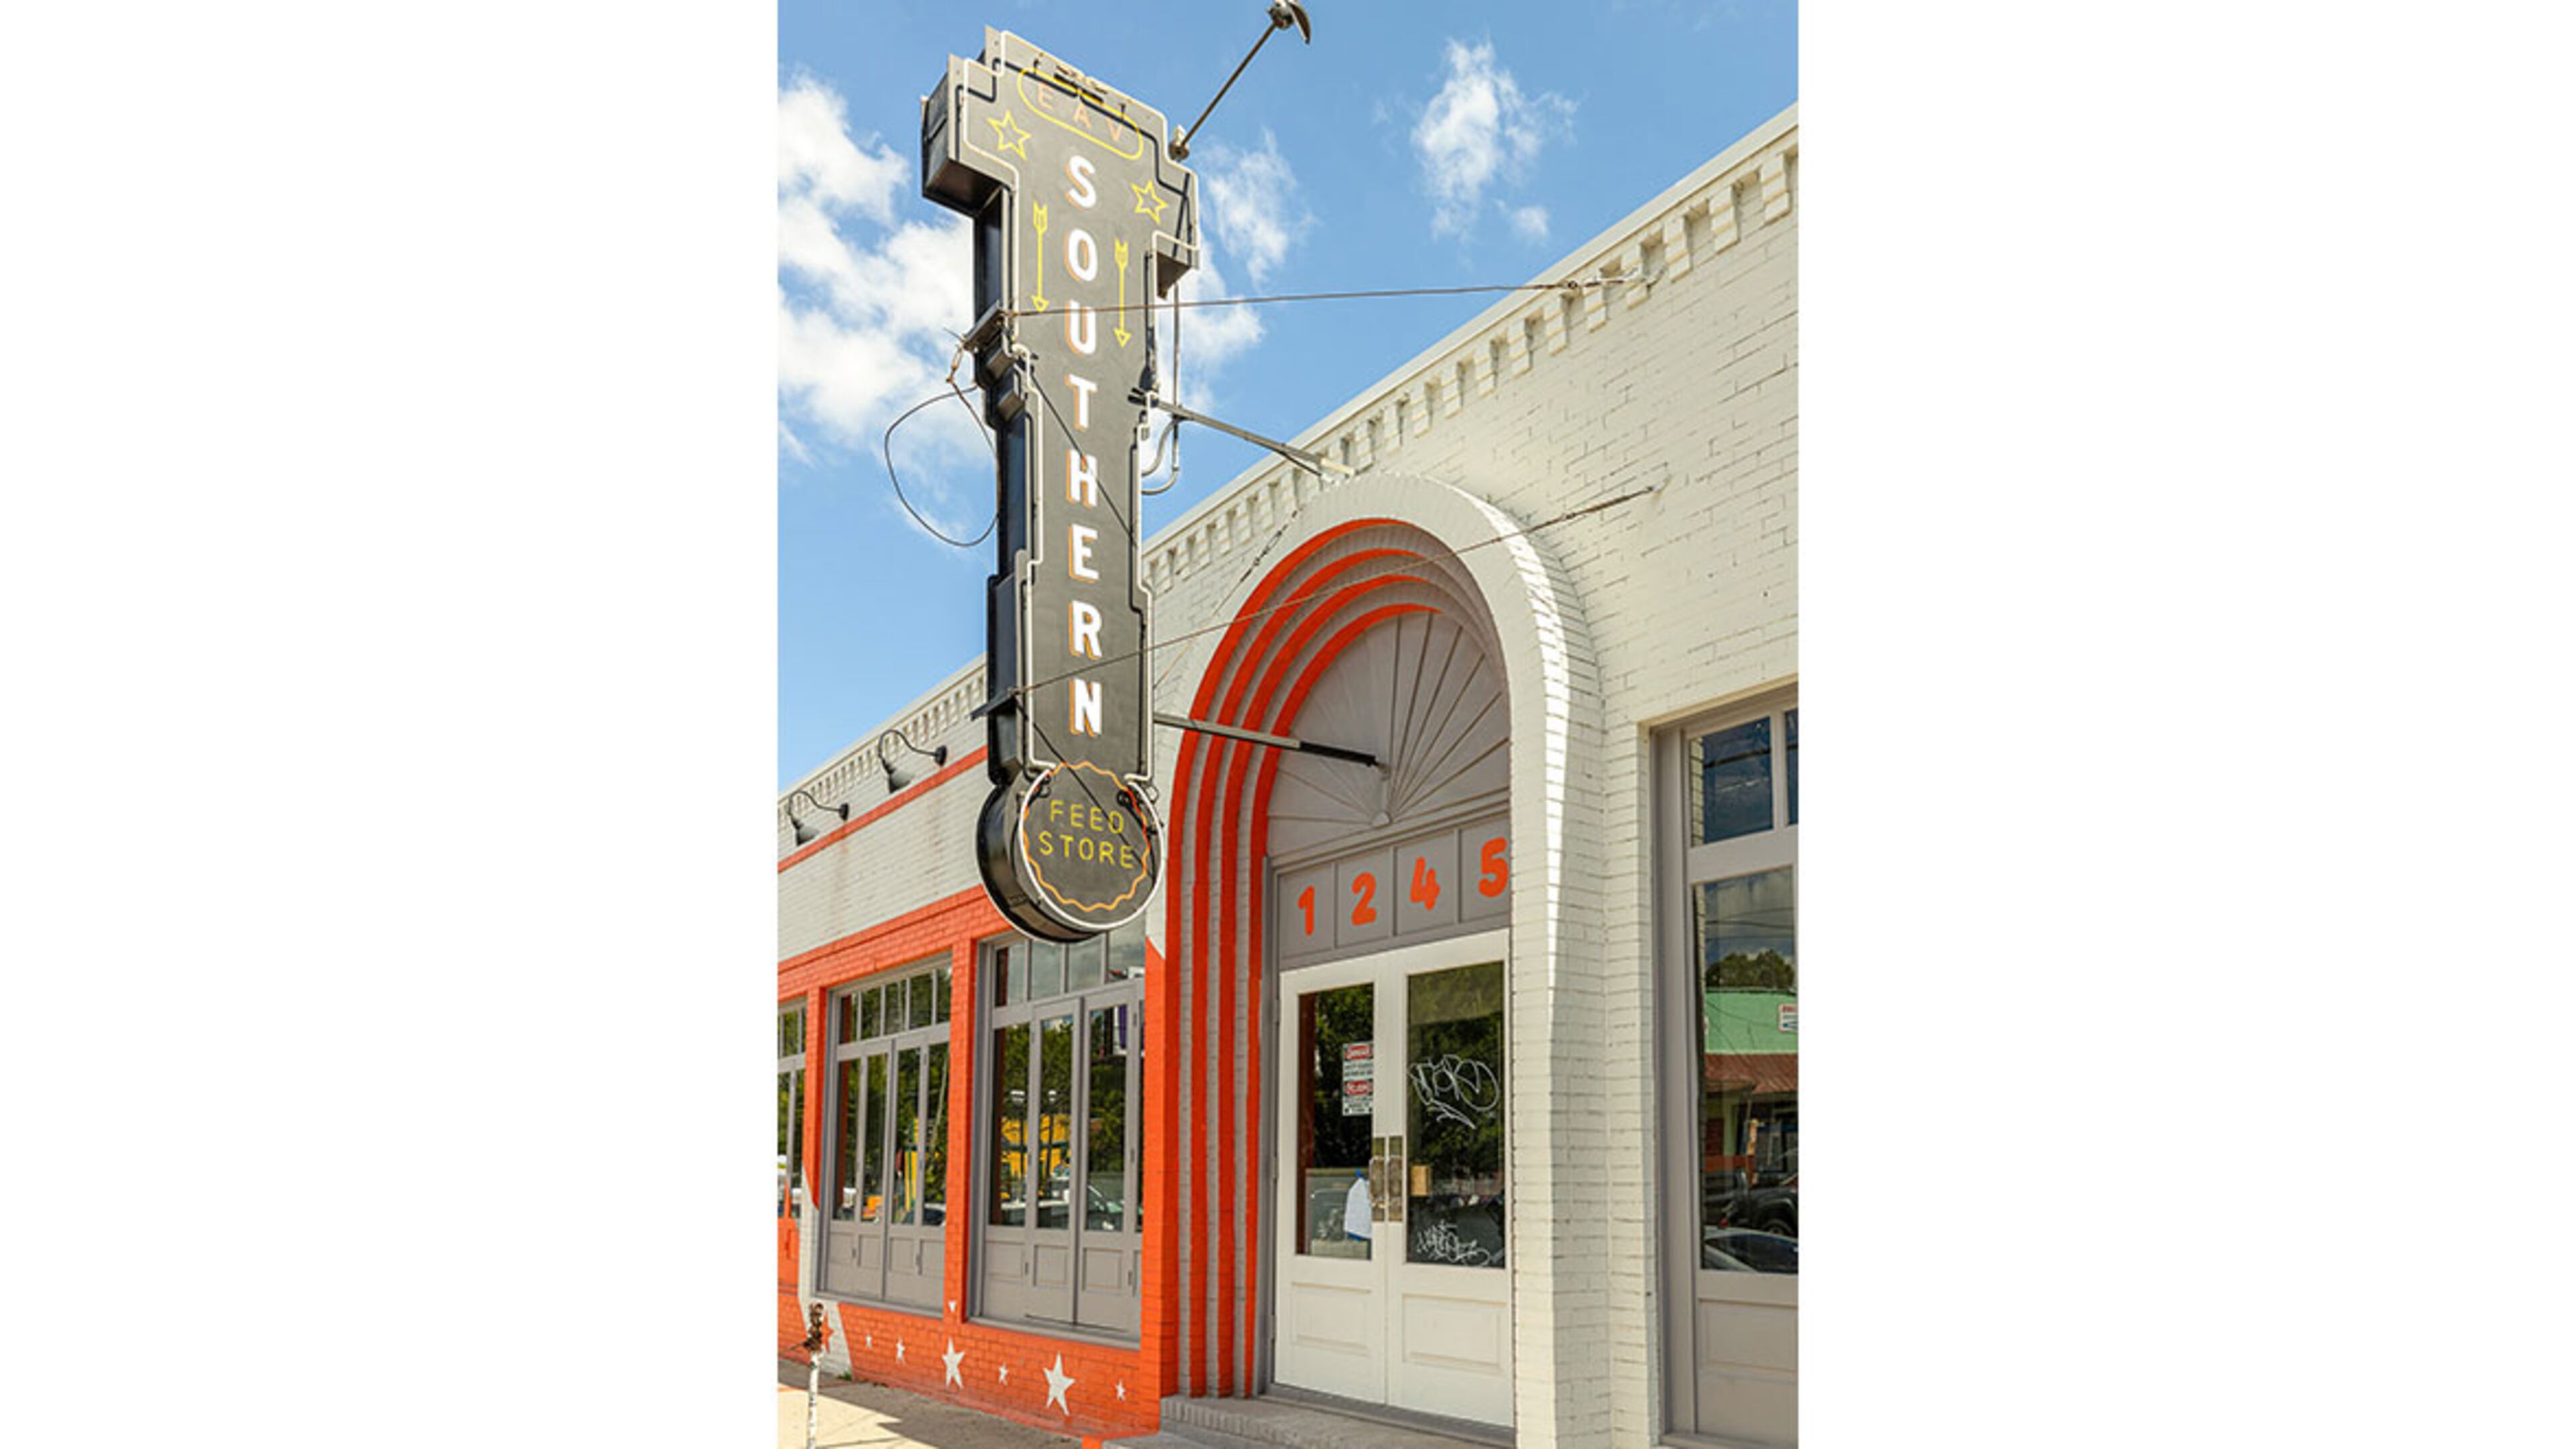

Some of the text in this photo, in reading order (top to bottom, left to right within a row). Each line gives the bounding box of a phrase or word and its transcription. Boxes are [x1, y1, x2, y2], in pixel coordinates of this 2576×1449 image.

[1037, 81, 1124, 142] EAV
[1063, 155, 1102, 738] SOUTHERN
[1050, 800, 1124, 834] FEED
[1038, 830, 1134, 869] STORE
